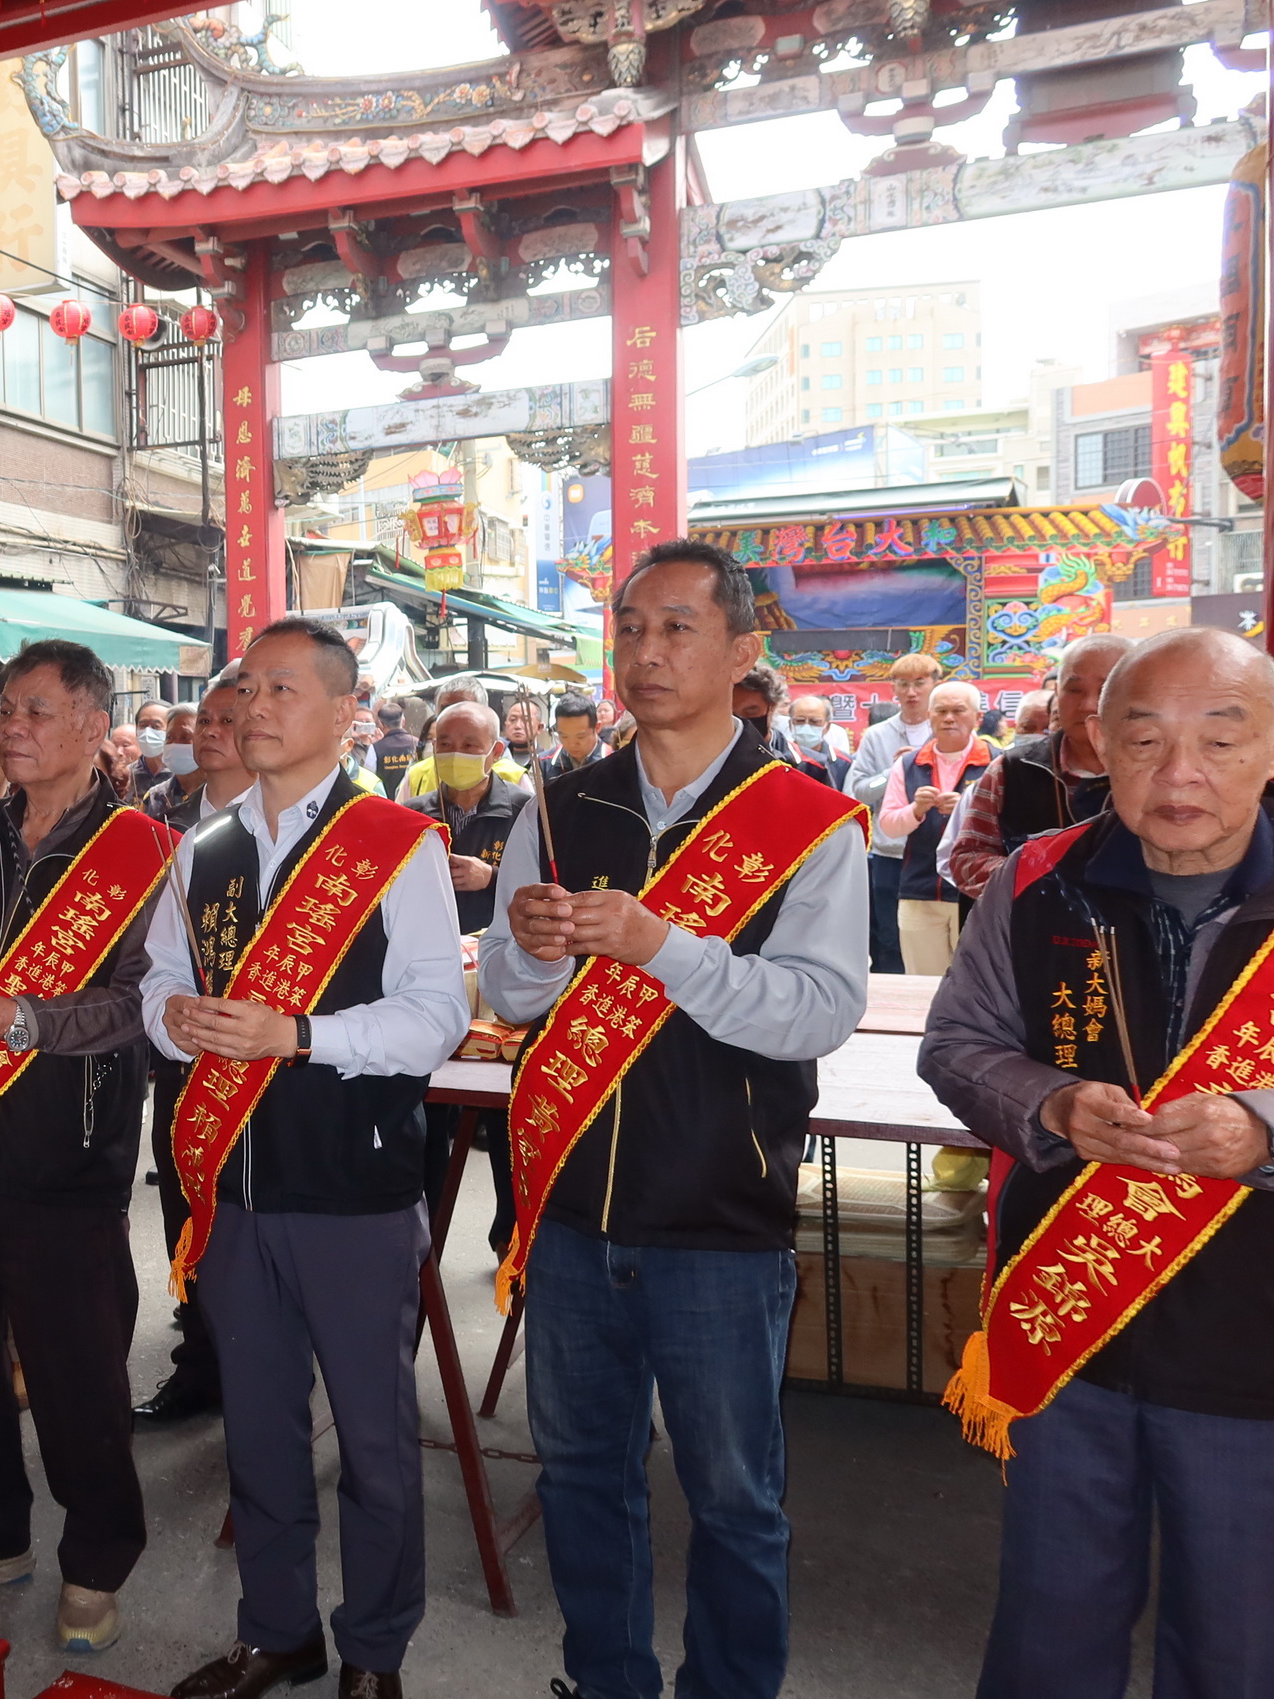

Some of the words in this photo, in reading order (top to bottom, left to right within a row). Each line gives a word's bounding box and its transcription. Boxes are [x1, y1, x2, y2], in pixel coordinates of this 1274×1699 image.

[82, 868, 128, 901] 彰化
[324, 843, 381, 882] 彰化
[702, 829, 775, 884] 彰化
[50, 890, 112, 956] 南瑤宮
[217, 875, 245, 972] 副大總理
[285, 872, 360, 957] 南瑤宮
[14, 955, 67, 999] 笨港進香
[31, 941, 75, 978] 甲辰年
[246, 961, 308, 1008] 笨港進香
[263, 944, 314, 983] 甲辰年
[603, 961, 659, 1007] 甲辰年
[579, 982, 637, 1041] 笨港進香
[1082, 949, 1111, 1043] 新大媽會
[1050, 981, 1078, 1069] 大總理
[1075, 1192, 1165, 1273] 大總理
[1009, 1233, 1119, 1356] 吳錦源
